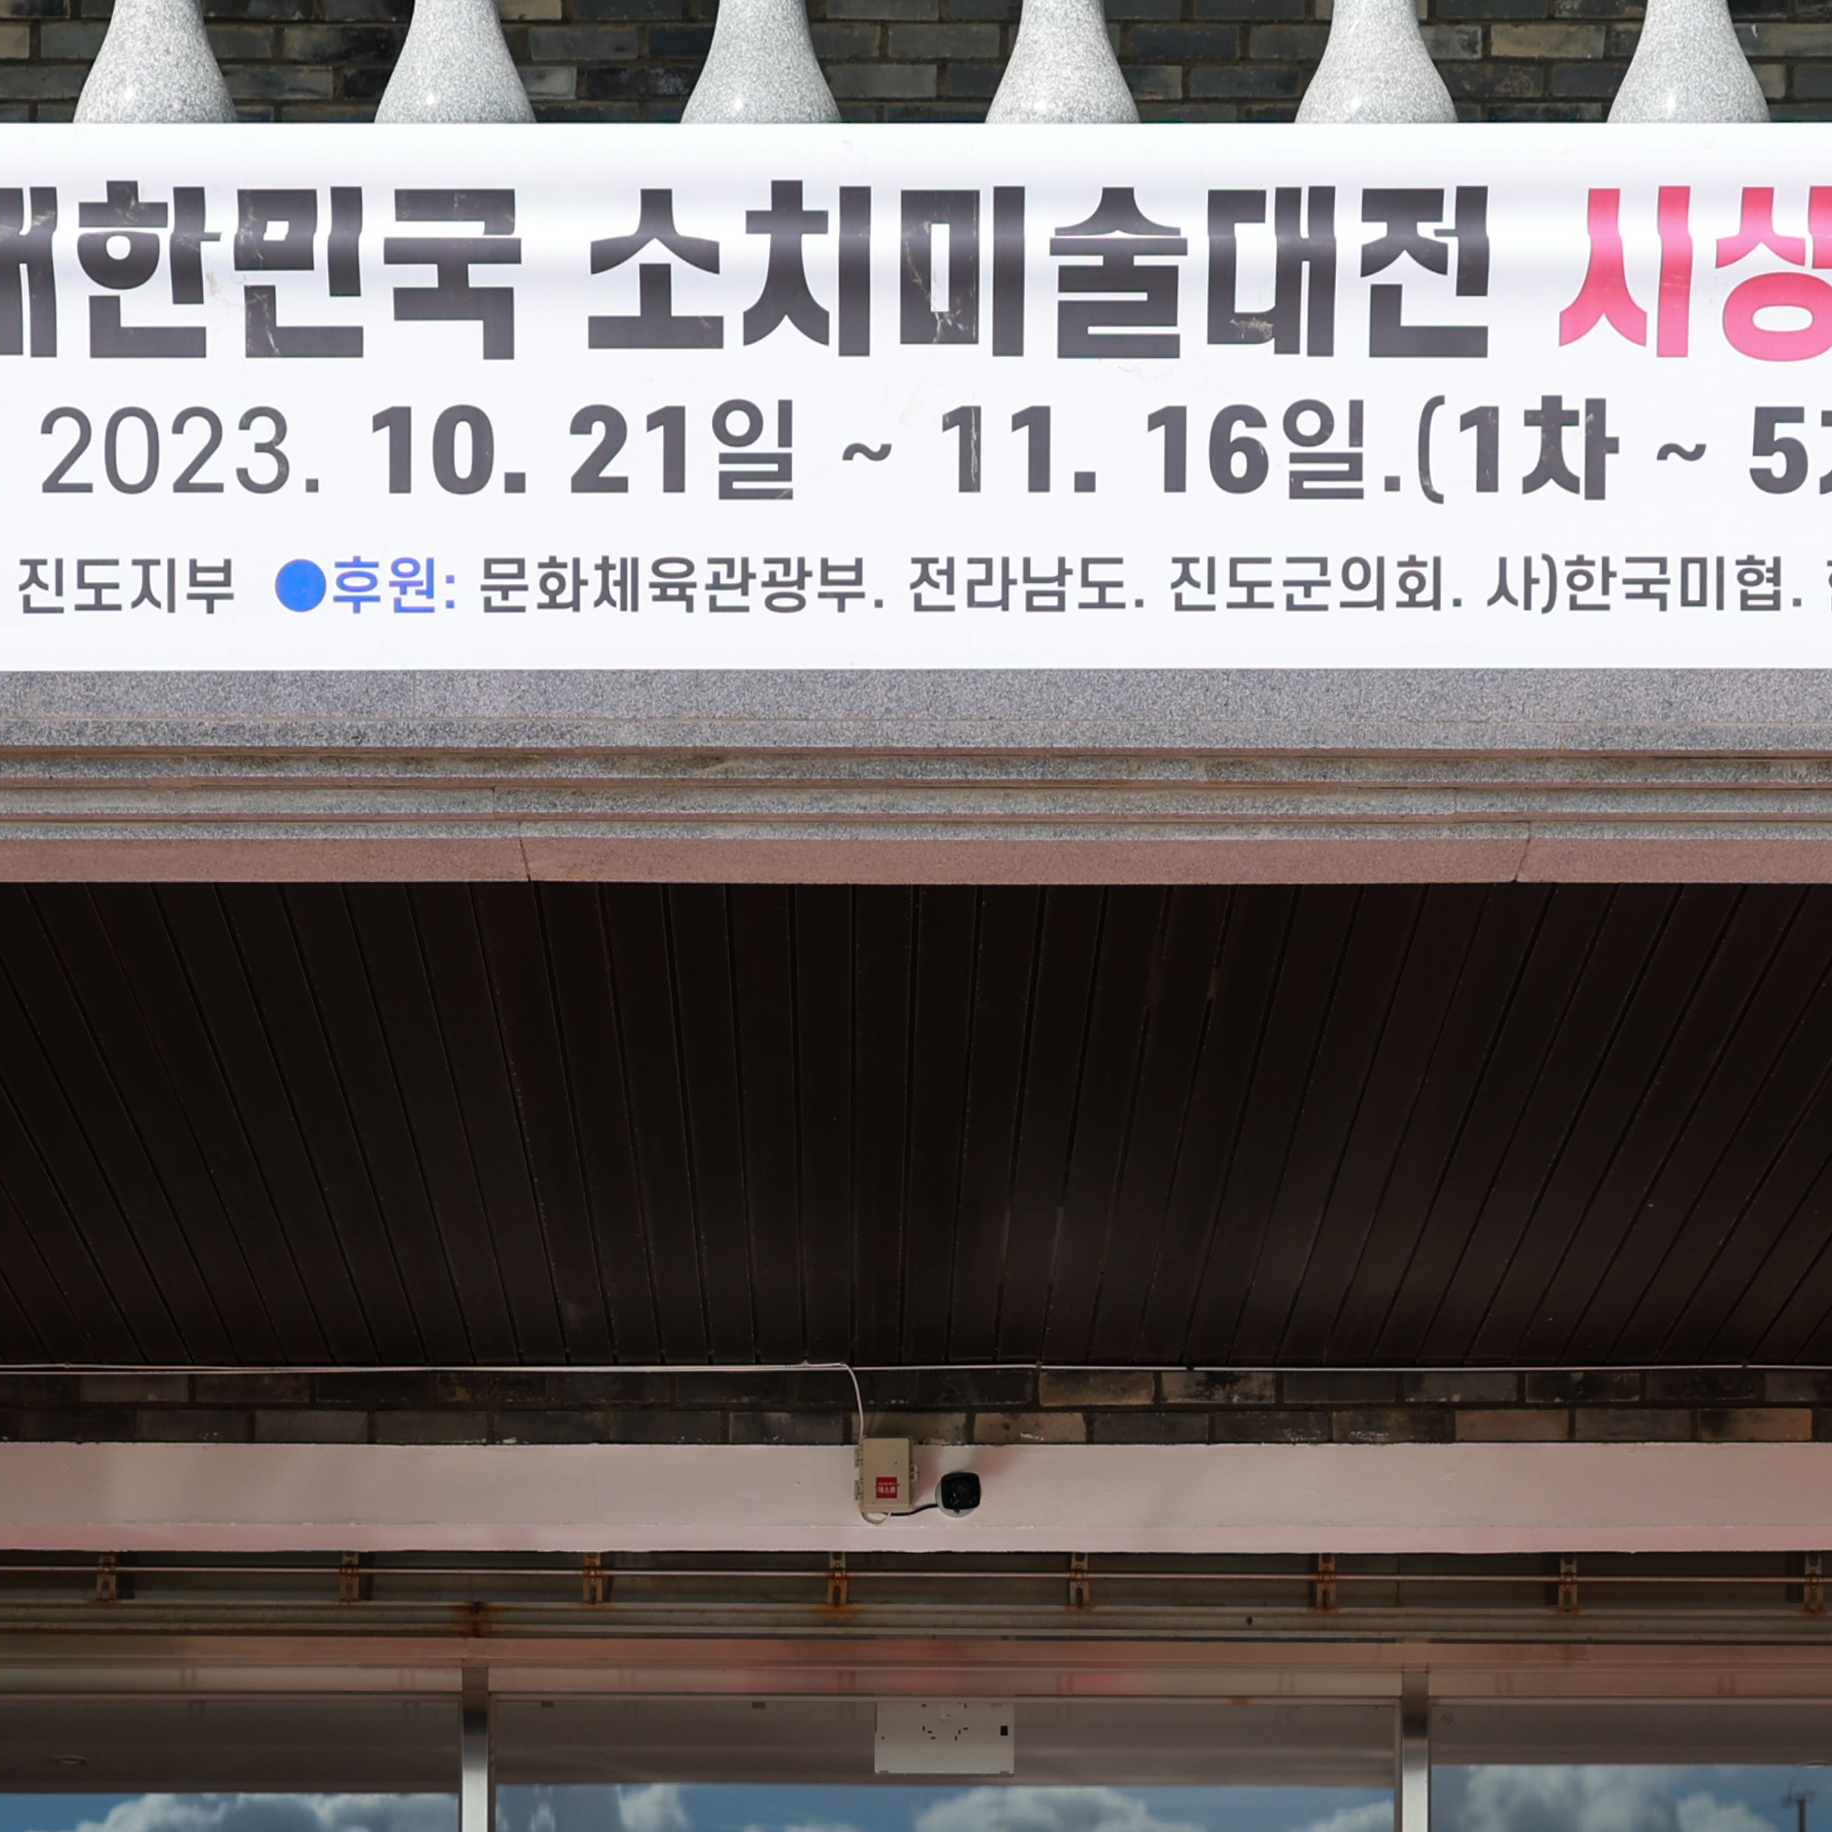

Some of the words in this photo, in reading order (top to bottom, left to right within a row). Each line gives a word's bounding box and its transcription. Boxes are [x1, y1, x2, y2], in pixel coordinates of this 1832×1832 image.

[589, 180, 1489, 359] 소치미술대전
[41, 406, 319, 495] 2023.
[373, 405, 526, 495] 10.
[570, 399, 794, 501] 21일
[943, 405, 1096, 493] 11.
[1147, 396, 1620, 505] 16일.(1차
[19, 558, 235, 615] 진도지부
[332, 557, 455, 614] 후원:
[481, 556, 884, 614] 문화체육관광부.
[910, 556, 1144, 613] 전라남도.
[1171, 555, 1462, 612] 진도군의회.
[1487, 554, 1802, 614] 사)한국미협.
